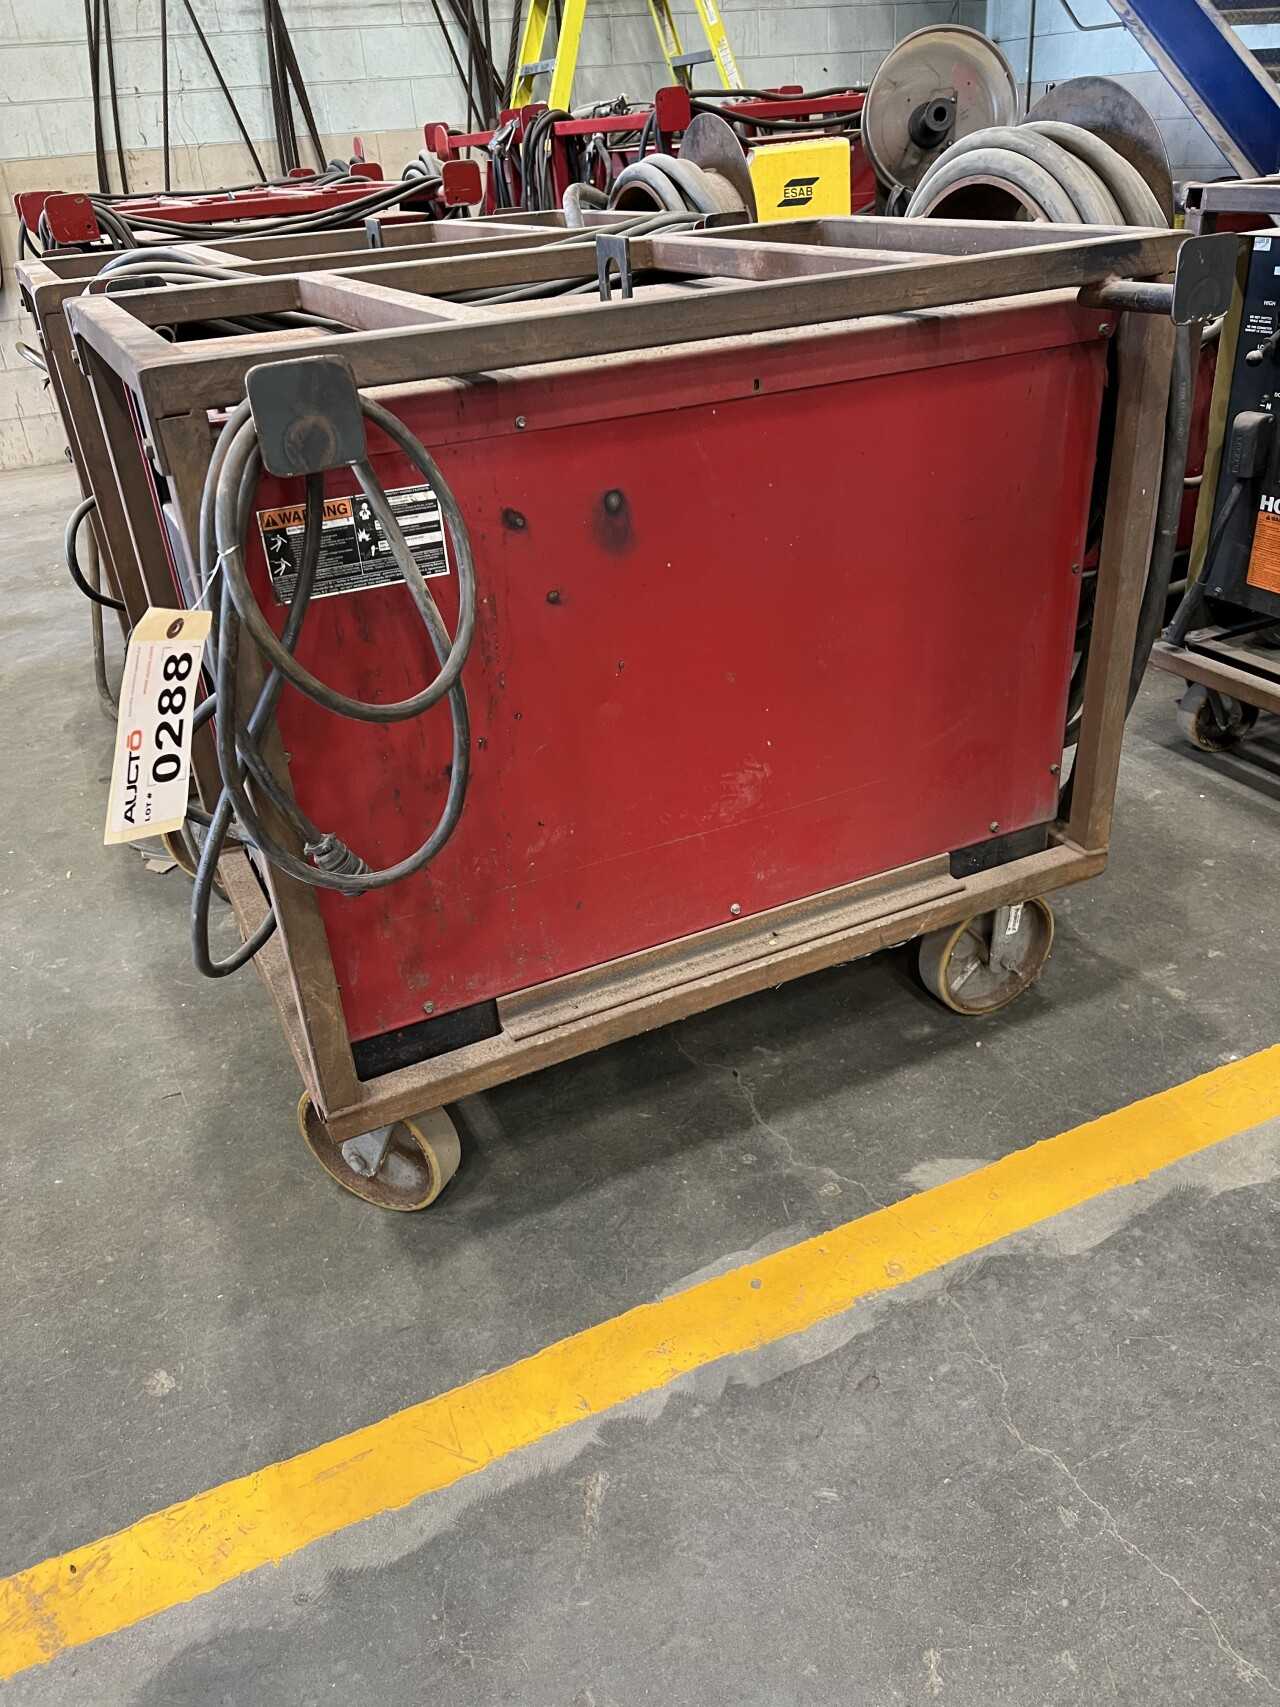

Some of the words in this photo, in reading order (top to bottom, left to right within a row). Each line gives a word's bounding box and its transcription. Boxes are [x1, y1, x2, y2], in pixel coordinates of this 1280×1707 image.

[783, 186, 813, 198] ESAB
[278, 503, 348, 524] WAING
[151, 652, 193, 783] 0288
[144, 802, 152, 822] LOT
